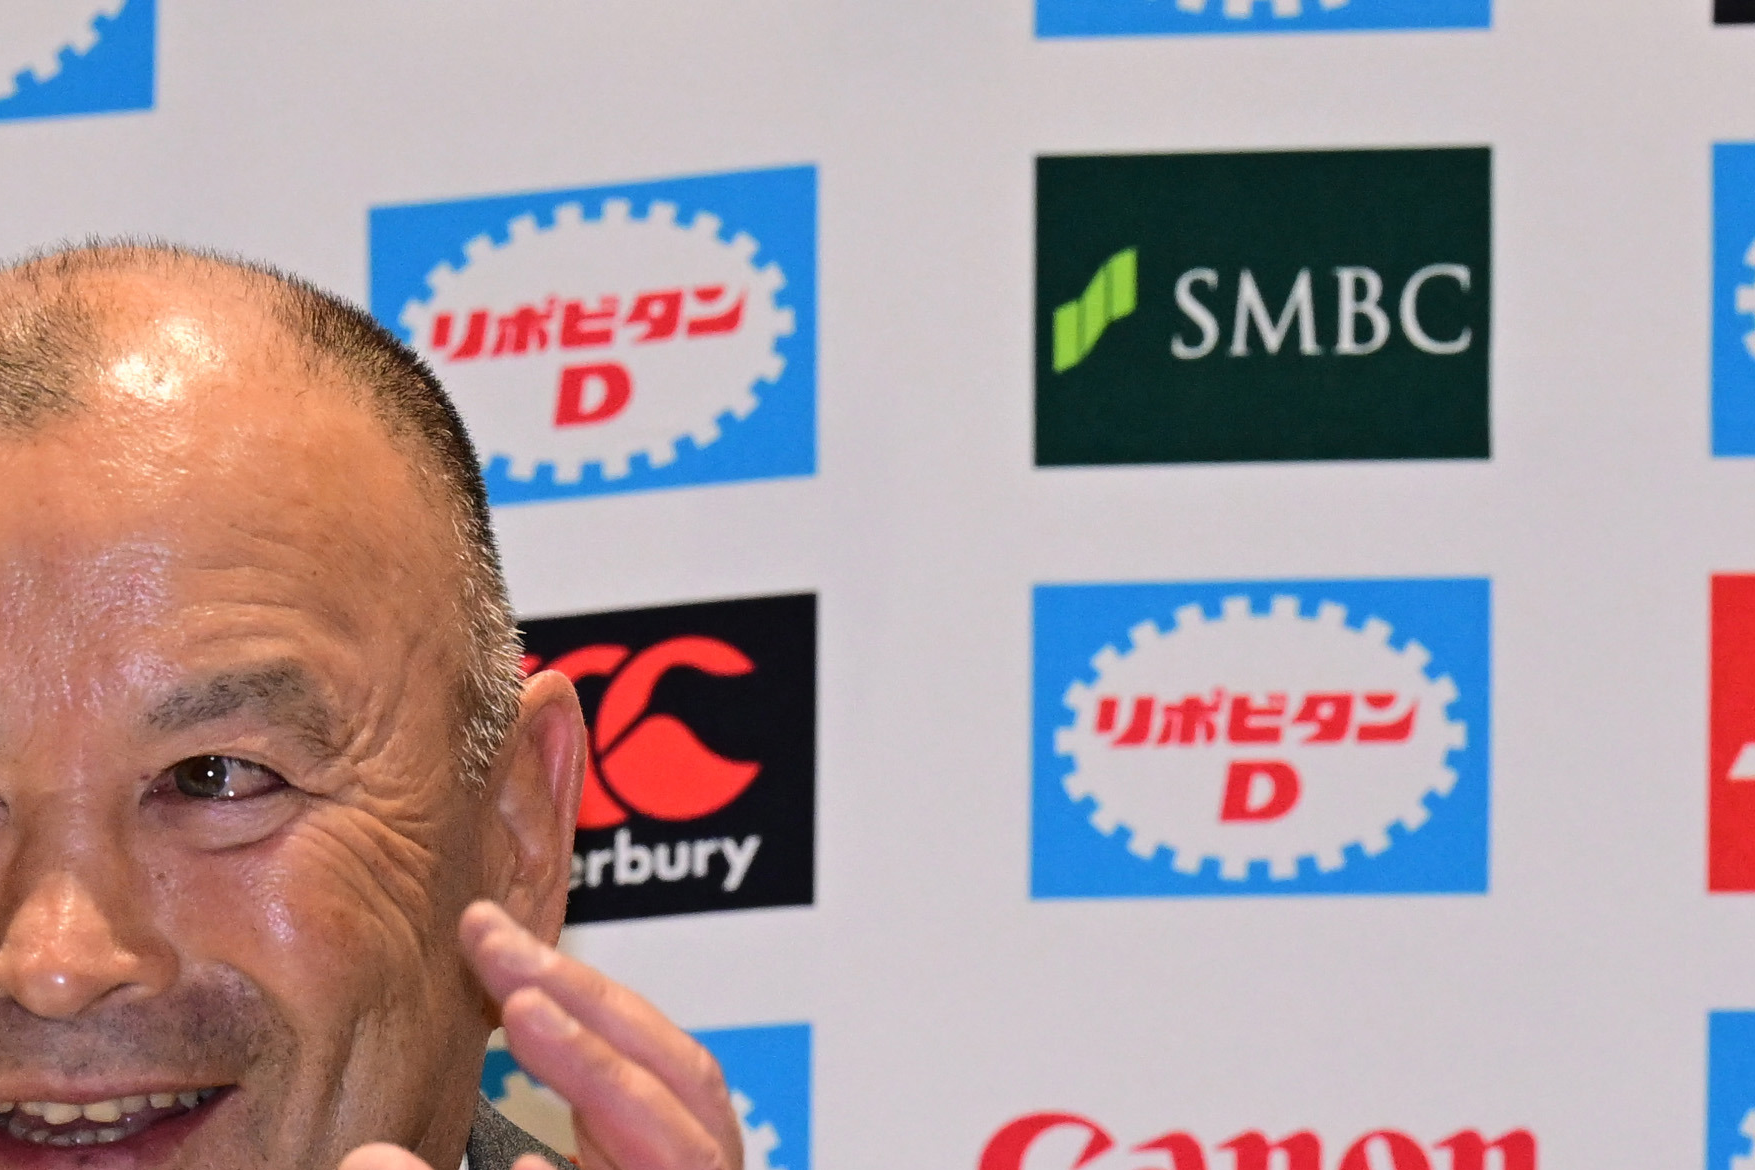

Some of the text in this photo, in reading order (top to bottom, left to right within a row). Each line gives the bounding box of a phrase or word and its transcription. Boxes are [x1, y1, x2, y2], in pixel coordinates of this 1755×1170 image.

[429, 284, 747, 363] リポビタン
[1170, 262, 1473, 361] SMBC
[553, 362, 634, 429] D
[1094, 688, 1418, 748] リポビタン
[1218, 760, 1303, 824] D
